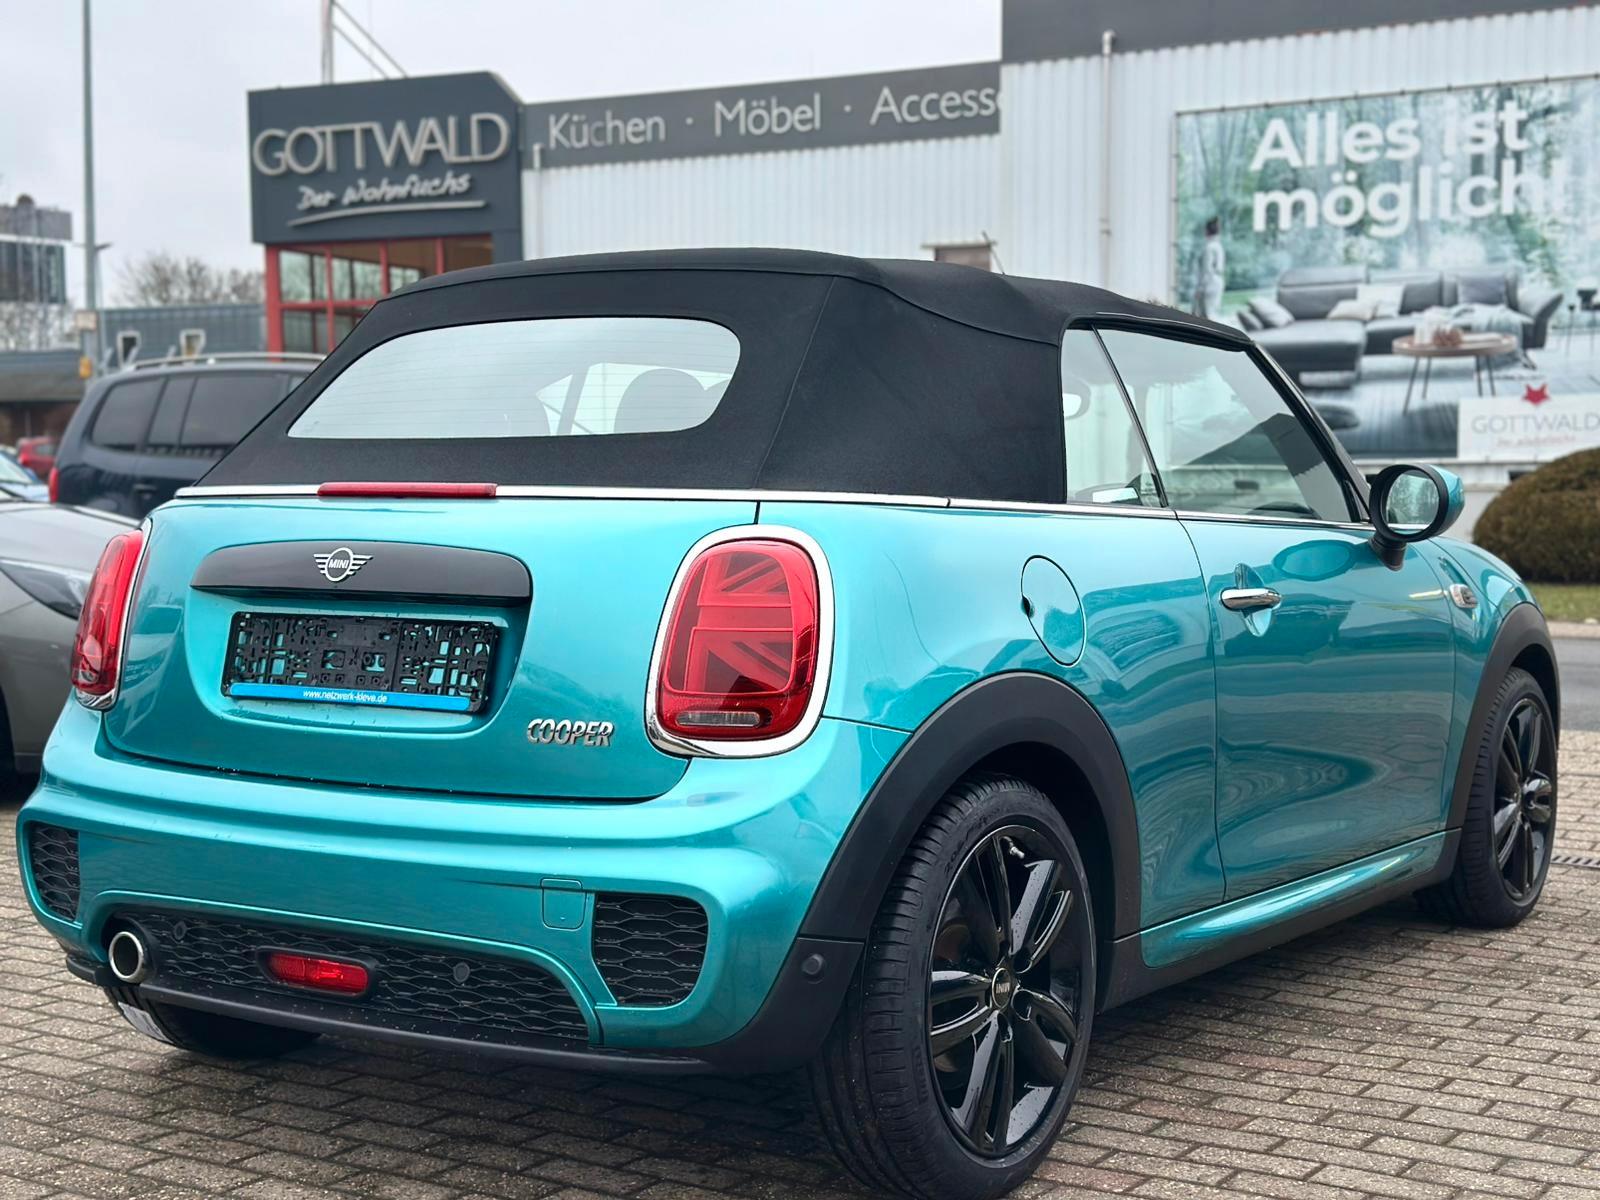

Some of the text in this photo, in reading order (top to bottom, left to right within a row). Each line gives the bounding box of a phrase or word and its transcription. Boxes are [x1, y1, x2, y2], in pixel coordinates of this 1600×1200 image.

[549, 109, 666, 149] Küchen
[714, 92, 821, 137] Möbel
[1250, 97, 1531, 172] Alles ist
[252, 112, 511, 176] GOTTWALD
[296, 170, 472, 210] Der Wohnfuchs
[1471, 411, 1600, 434] GOTTWALD
[329, 559, 349, 569] MINI
[302, 690, 388, 703] www.netzwerk-kleve.de
[527, 718, 614, 747] COOPER
